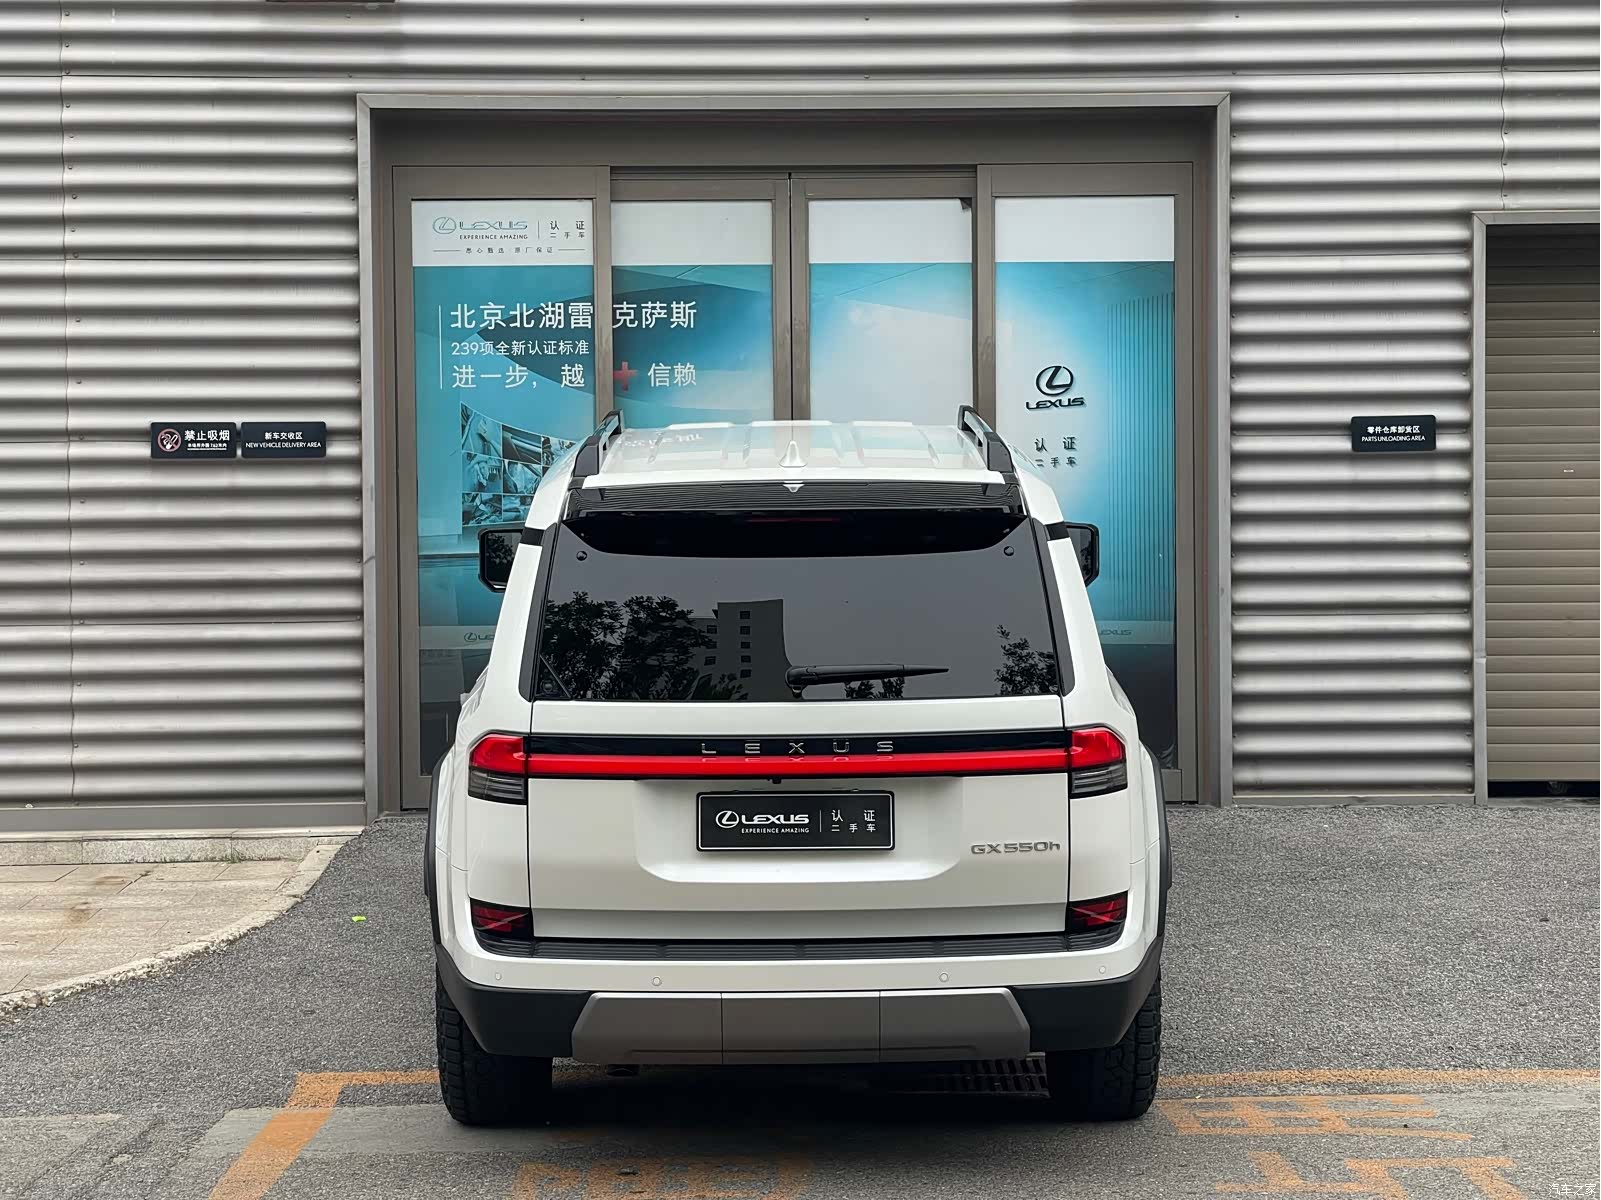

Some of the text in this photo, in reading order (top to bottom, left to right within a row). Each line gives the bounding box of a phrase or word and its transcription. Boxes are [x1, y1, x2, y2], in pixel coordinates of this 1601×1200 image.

[459, 220, 528, 231] LEXUS
[549, 219, 586, 231] 认证
[459, 233, 529, 241] EXPERIENCE AMAZING
[549, 231, 586, 239] 二手车
[450, 340, 590, 357] 239项全新认证标准
[1025, 396, 1086, 411] LEXUS
[184, 429, 231, 442] 禁止吸烟
[1361, 435, 1378, 443] PARTS
[245, 441, 260, 449] NEW
[259, 441, 282, 449] VEHICLE
[1034, 436, 1078, 453] 认证
[1034, 456, 1078, 468] 二手车
[700, 740, 895, 755] LEXUS
[741, 813, 811, 825] LEXUS
[830, 808, 877, 823] 认证
[741, 827, 780, 835] EXPERIENCE
[830, 822, 877, 834] 二手车
